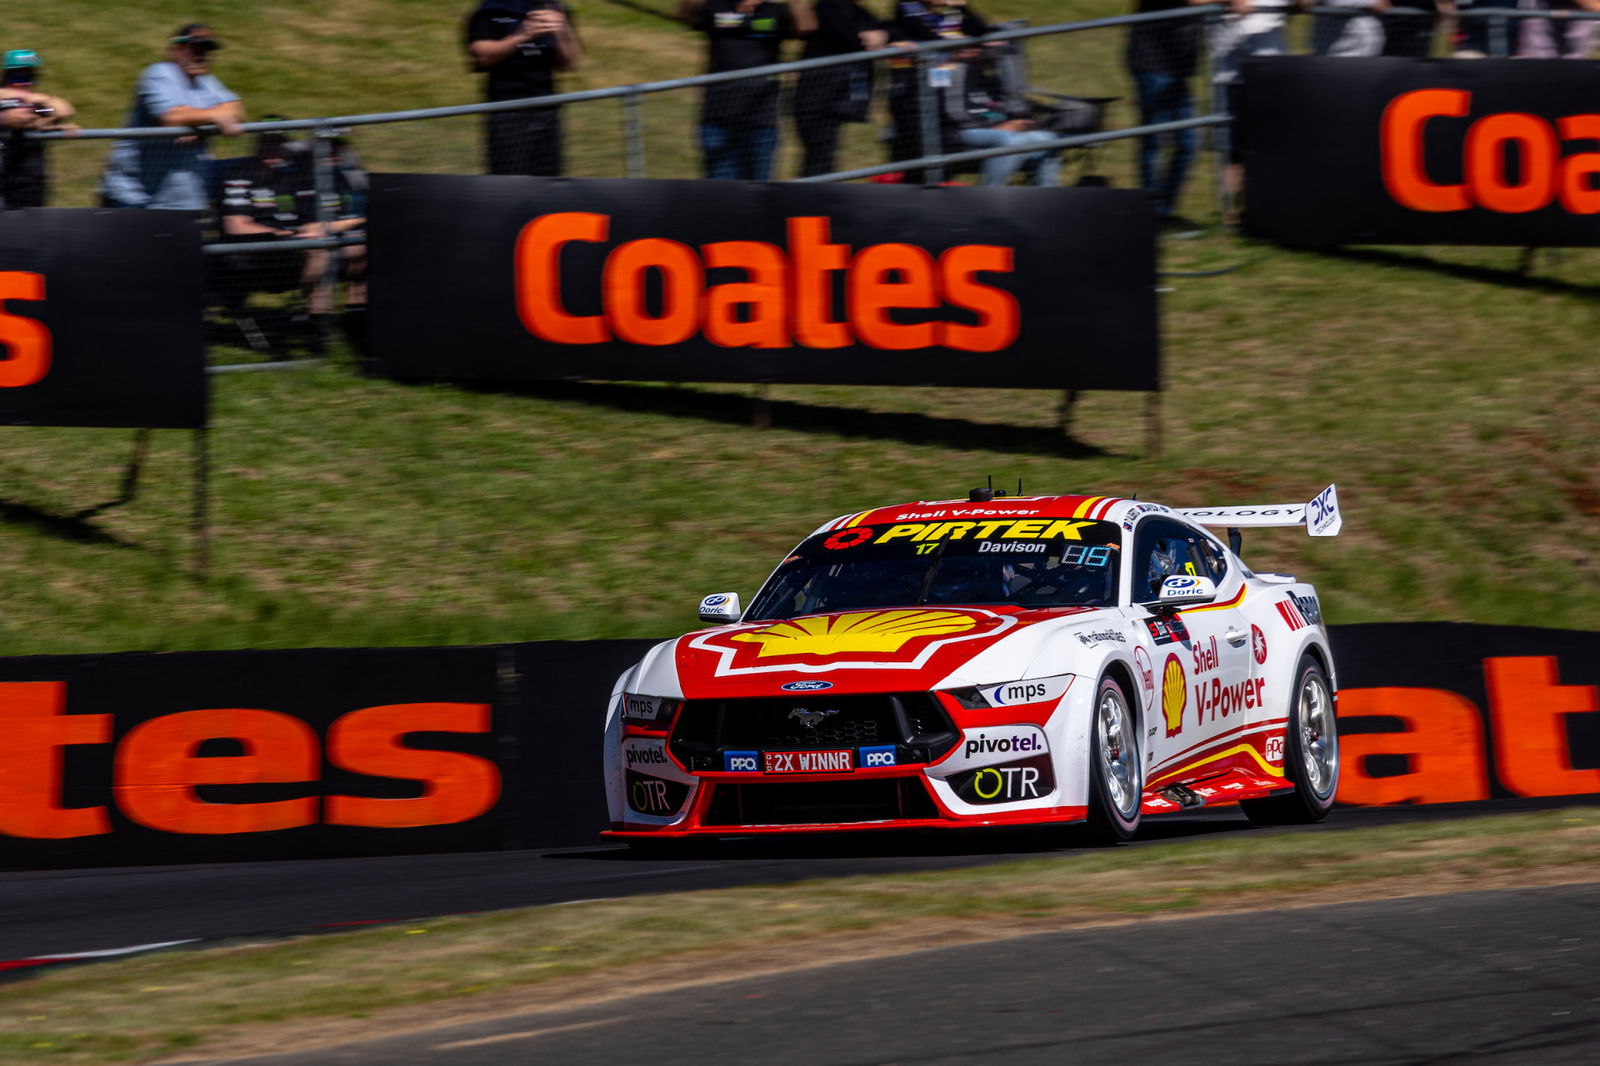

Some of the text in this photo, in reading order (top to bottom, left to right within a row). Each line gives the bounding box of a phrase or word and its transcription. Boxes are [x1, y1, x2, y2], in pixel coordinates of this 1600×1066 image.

[514, 211, 1020, 352] Coates
[895, 508, 1040, 521] Shell V-Power
[1182, 508, 1302, 517] OLOGY
[873, 519, 1098, 544] PIRTEK
[915, 543, 940, 555] 17
[978, 540, 1047, 554] Davison
[1167, 588, 1204, 596] Doric
[698, 606, 724, 614] Doric
[1192, 635, 1219, 675] Shell
[790, 681, 823, 690] Ford
[1008, 682, 1046, 702] mps
[630, 699, 653, 717] mps
[1195, 677, 1265, 726] V-Power
[965, 733, 1042, 758] pivotel.
[0, 680, 502, 839] tes
[626, 744, 668, 768] pivotel.
[774, 752, 851, 771] 2X WINNR
[974, 767, 1039, 799] OTR
[633, 780, 671, 811] OTR
